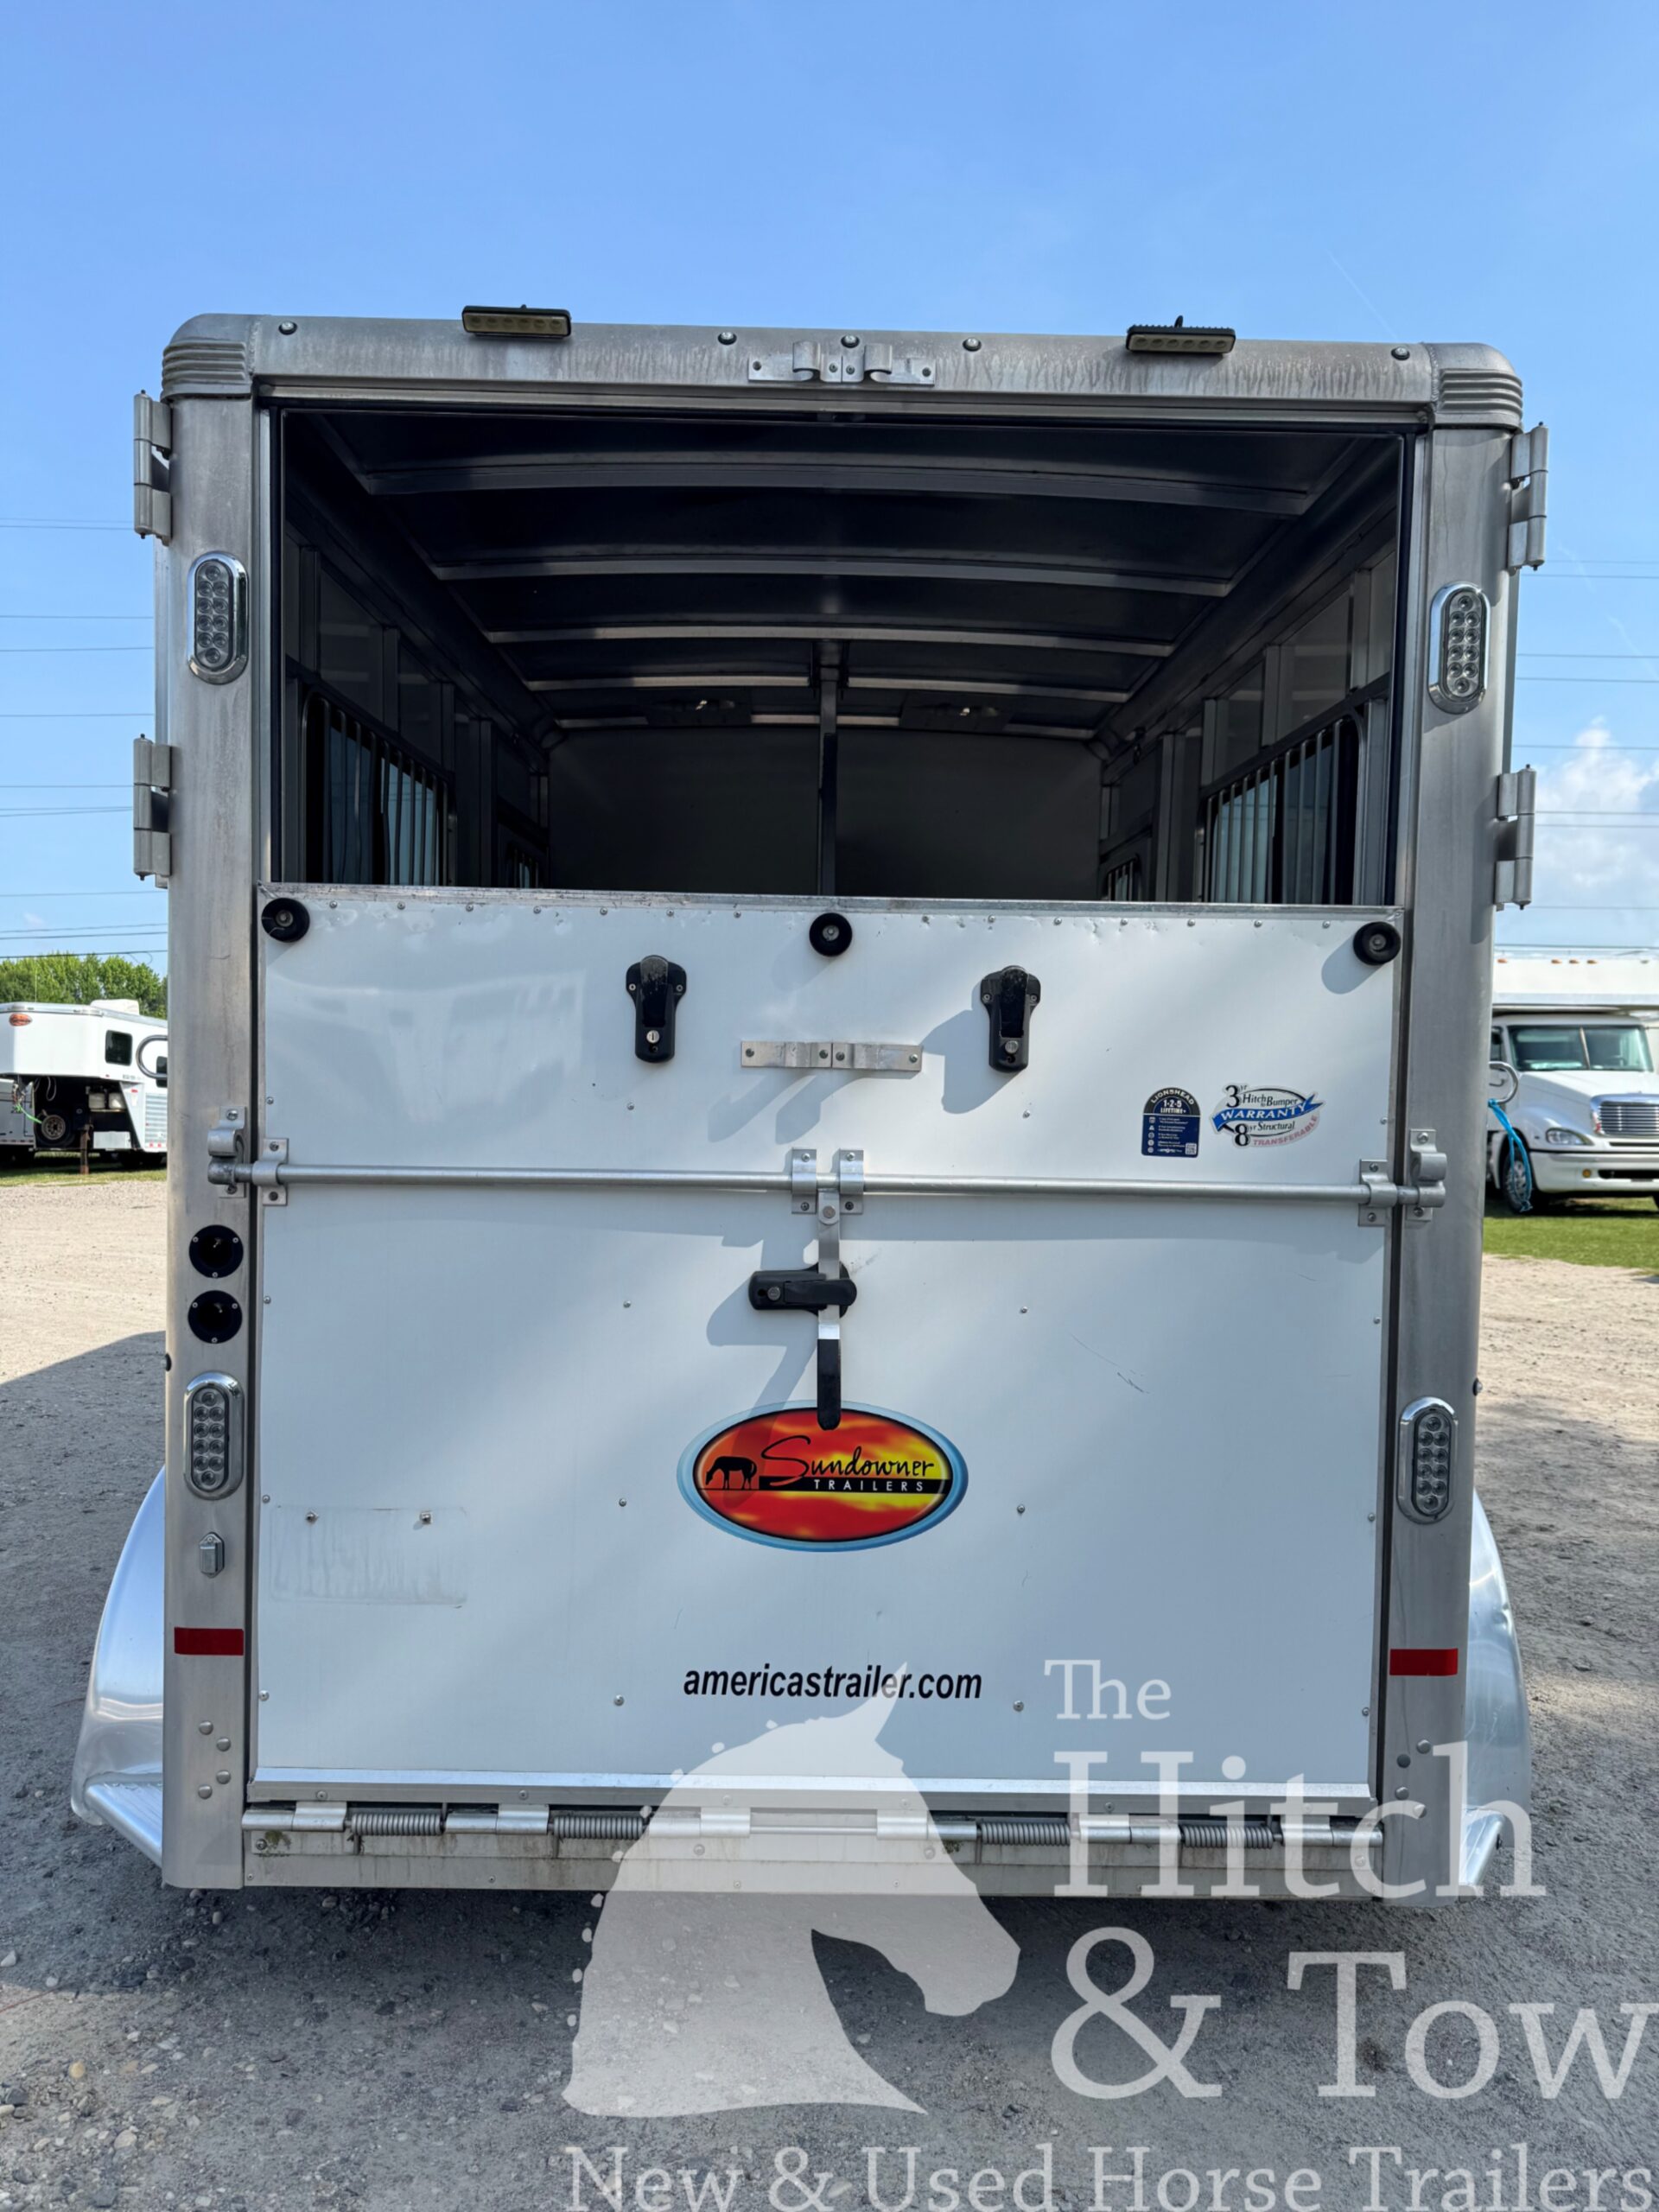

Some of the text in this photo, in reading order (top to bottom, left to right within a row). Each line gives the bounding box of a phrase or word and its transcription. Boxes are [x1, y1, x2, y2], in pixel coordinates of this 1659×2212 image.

[1151, 1090, 1194, 1105] LIONSHEAD
[1225, 1084, 1240, 1108] 3
[1242, 1094, 1267, 1104] Hitch
[1266, 1096, 1299, 1107] Bumper
[1221, 1101, 1308, 1121] WARRANTY
[1235, 1123, 1249, 1147] 8
[1257, 1120, 1296, 1131] Structural
[1254, 1115, 1318, 1147] TRANSFERABLE
[761, 1434, 935, 1487] Sundowner
[814, 1479, 924, 1492] TRAILERS
[683, 1663, 982, 1699] americastrailer.com
